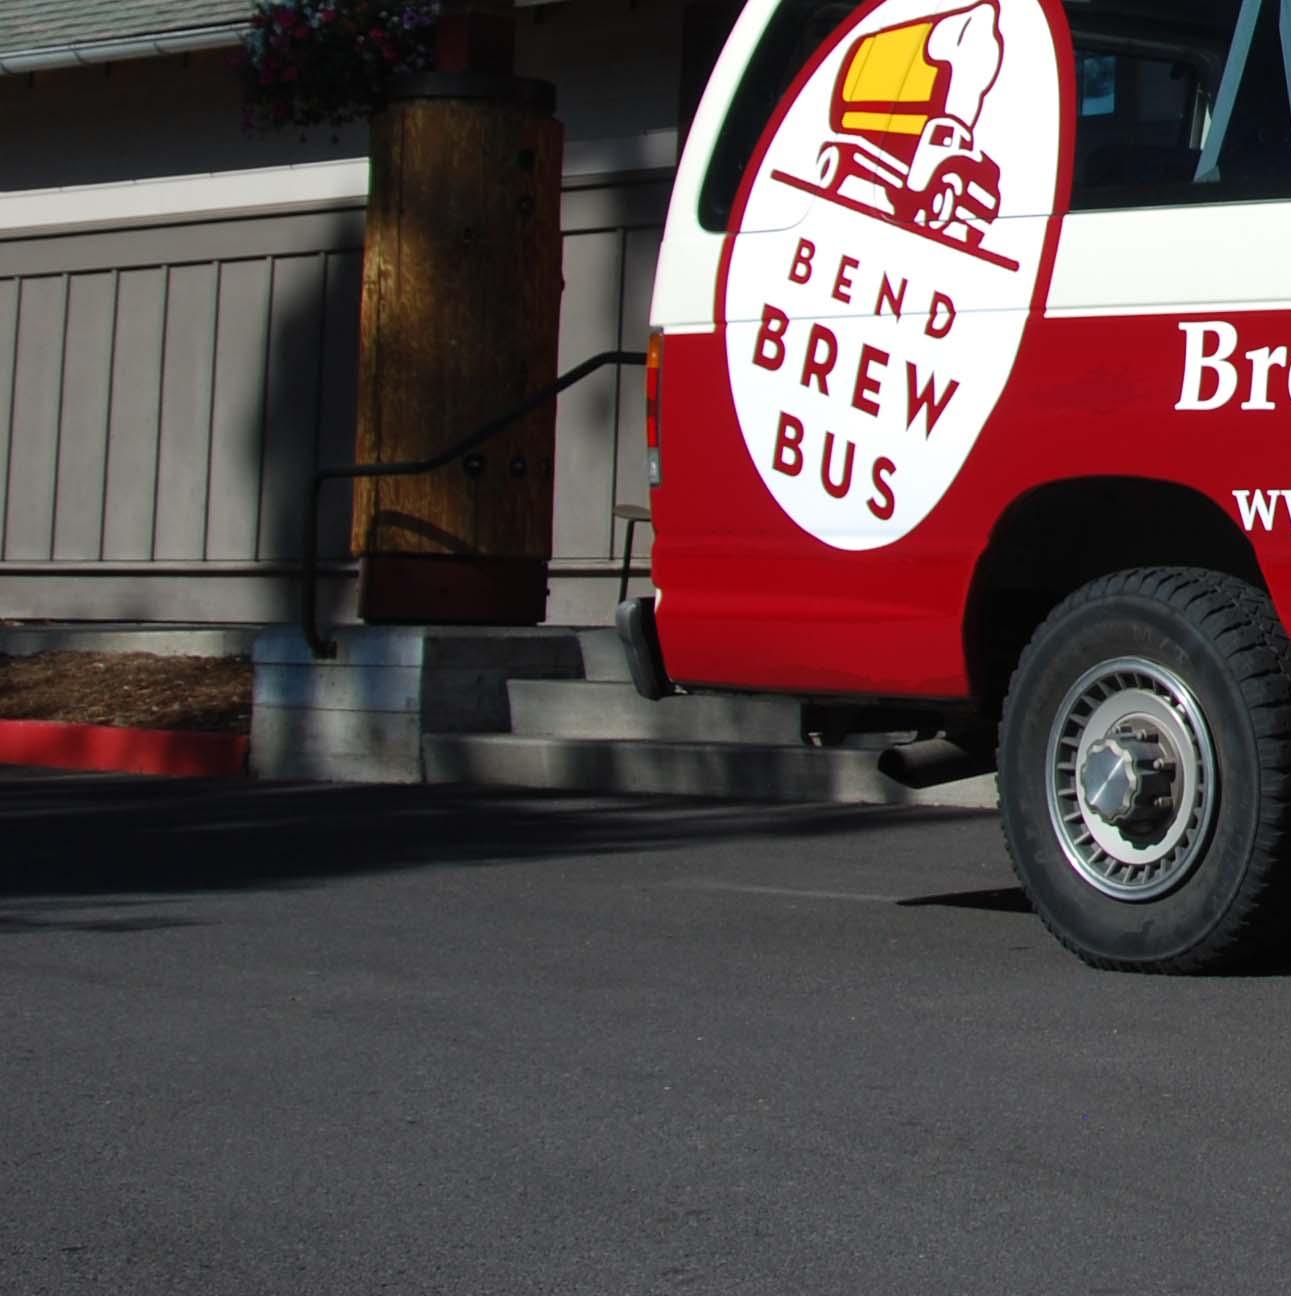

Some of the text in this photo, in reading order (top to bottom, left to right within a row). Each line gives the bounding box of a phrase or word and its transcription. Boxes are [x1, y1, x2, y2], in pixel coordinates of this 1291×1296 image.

[787, 236, 957, 340] BEND
[751, 302, 960, 440] BREW
[771, 410, 897, 522] BUS
